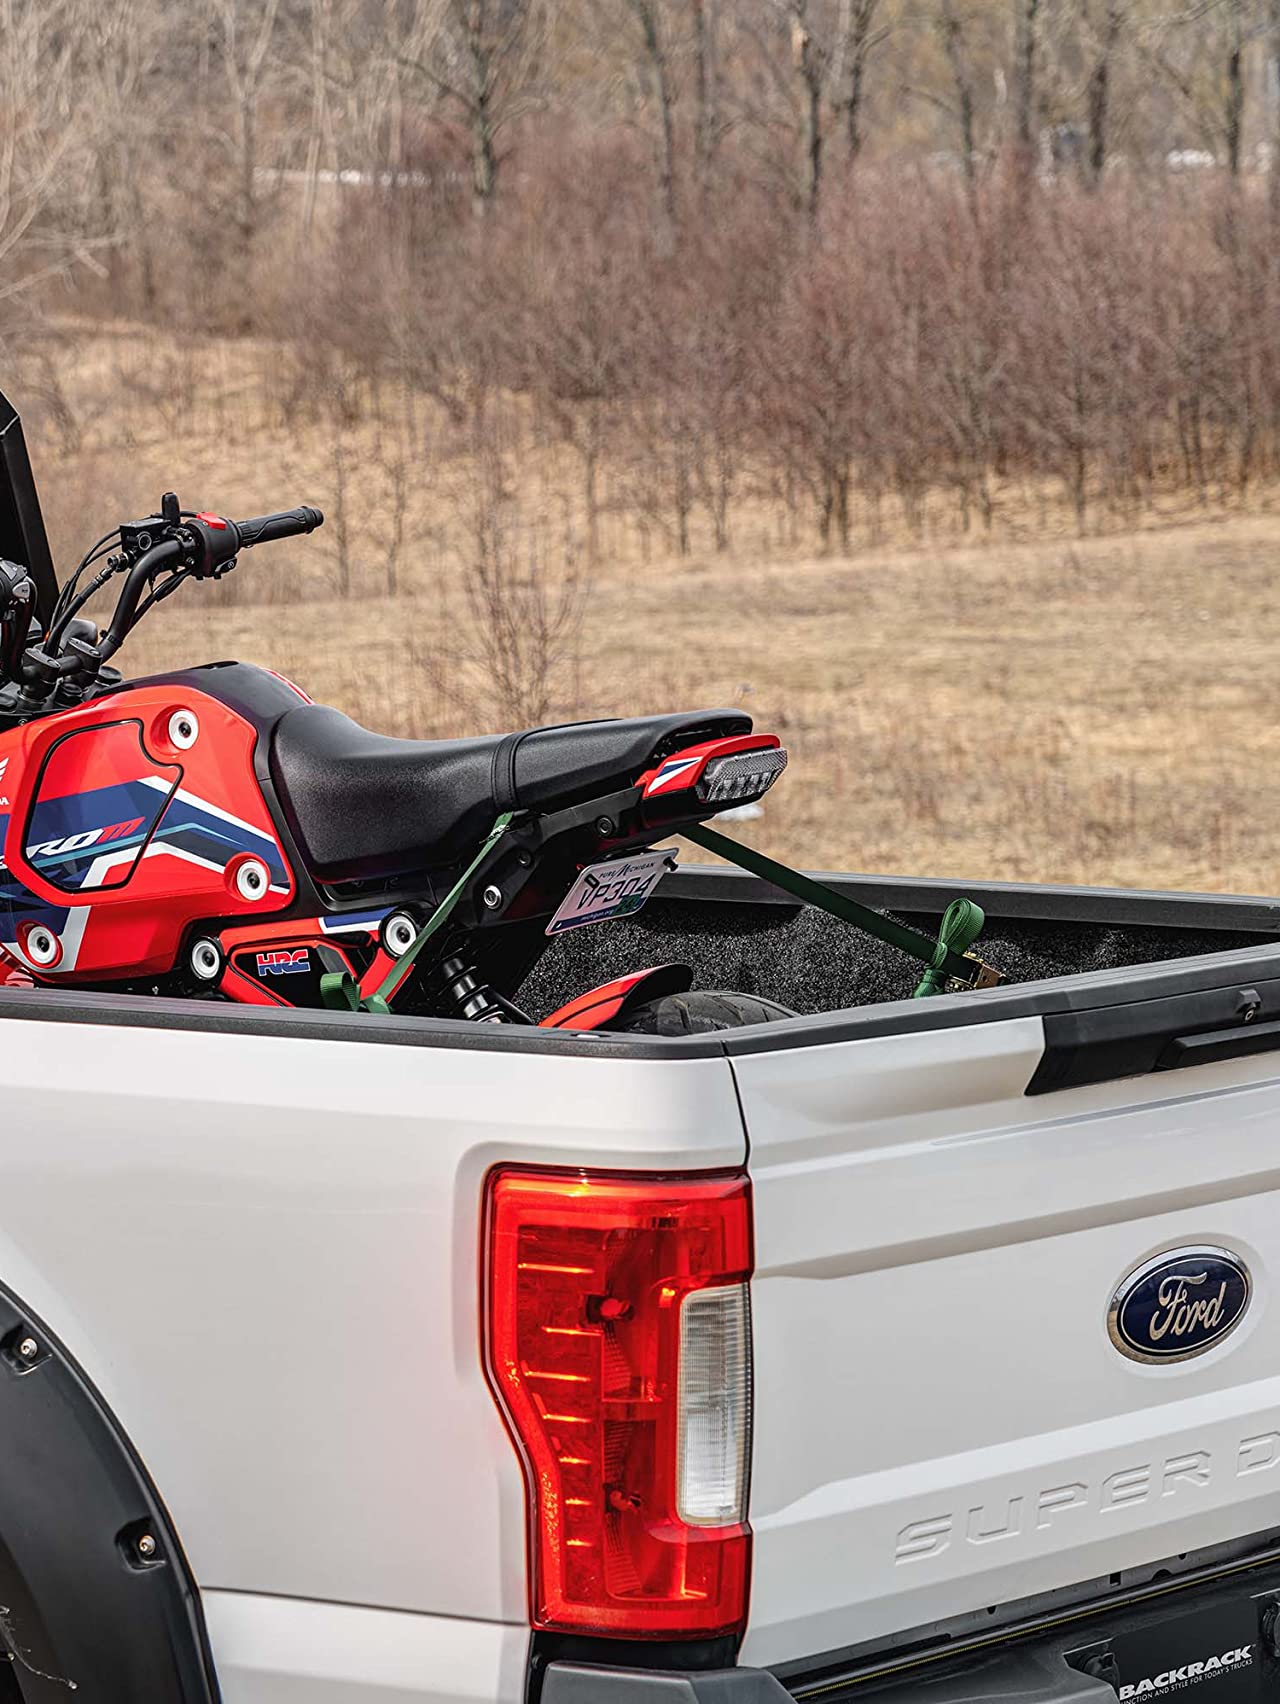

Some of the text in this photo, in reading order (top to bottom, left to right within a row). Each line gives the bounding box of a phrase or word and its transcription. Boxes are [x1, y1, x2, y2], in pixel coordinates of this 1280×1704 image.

[256, 948, 311, 977] HRC
[1149, 1272, 1227, 1342] Ford
[895, 1450, 1212, 1566] SUPER
[1119, 1645, 1253, 1701] BACKRACK
[1154, 1686, 1169, 1697] AND
[1170, 1679, 1189, 1690] STYLE
[1190, 1674, 1203, 1685] FOR
[1204, 1666, 1230, 1679] TODAY'S
[1230, 1658, 1253, 1671] TRUCKS
